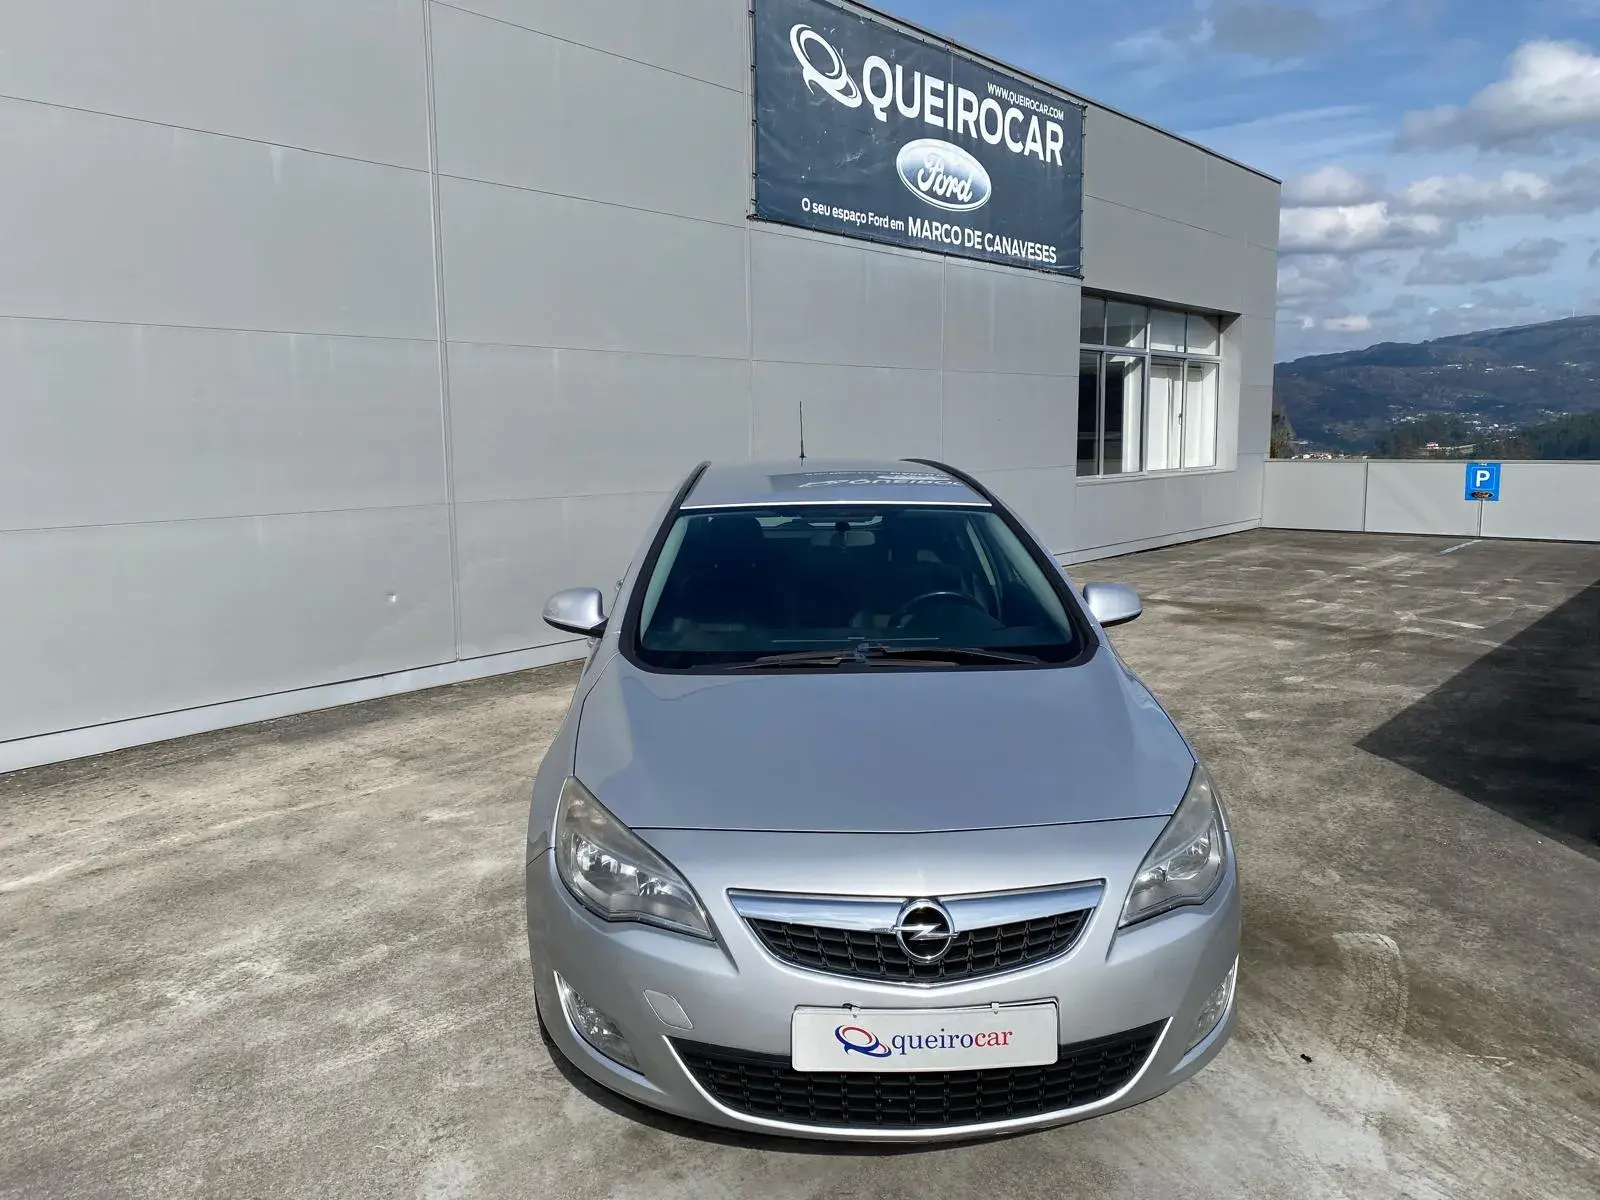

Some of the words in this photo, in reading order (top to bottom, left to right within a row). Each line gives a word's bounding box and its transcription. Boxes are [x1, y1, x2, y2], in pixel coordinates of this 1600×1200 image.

[863, 55, 1064, 166] QUEIROCAR
[987, 82, 1064, 120] WWW.QUEIROCAR.COM
[917, 152, 973, 203] Ford
[802, 197, 811, 212] O
[812, 202, 831, 216] seu
[832, 207, 867, 226] espaço
[868, 212, 889, 229] Ford
[890, 219, 905, 231] em
[908, 216, 962, 245] MARCO
[964, 228, 983, 249] DE
[984, 232, 1057, 264] CANAVESES
[1475, 470, 1490, 487] P
[892, 1028, 1013, 1055] queirocar
